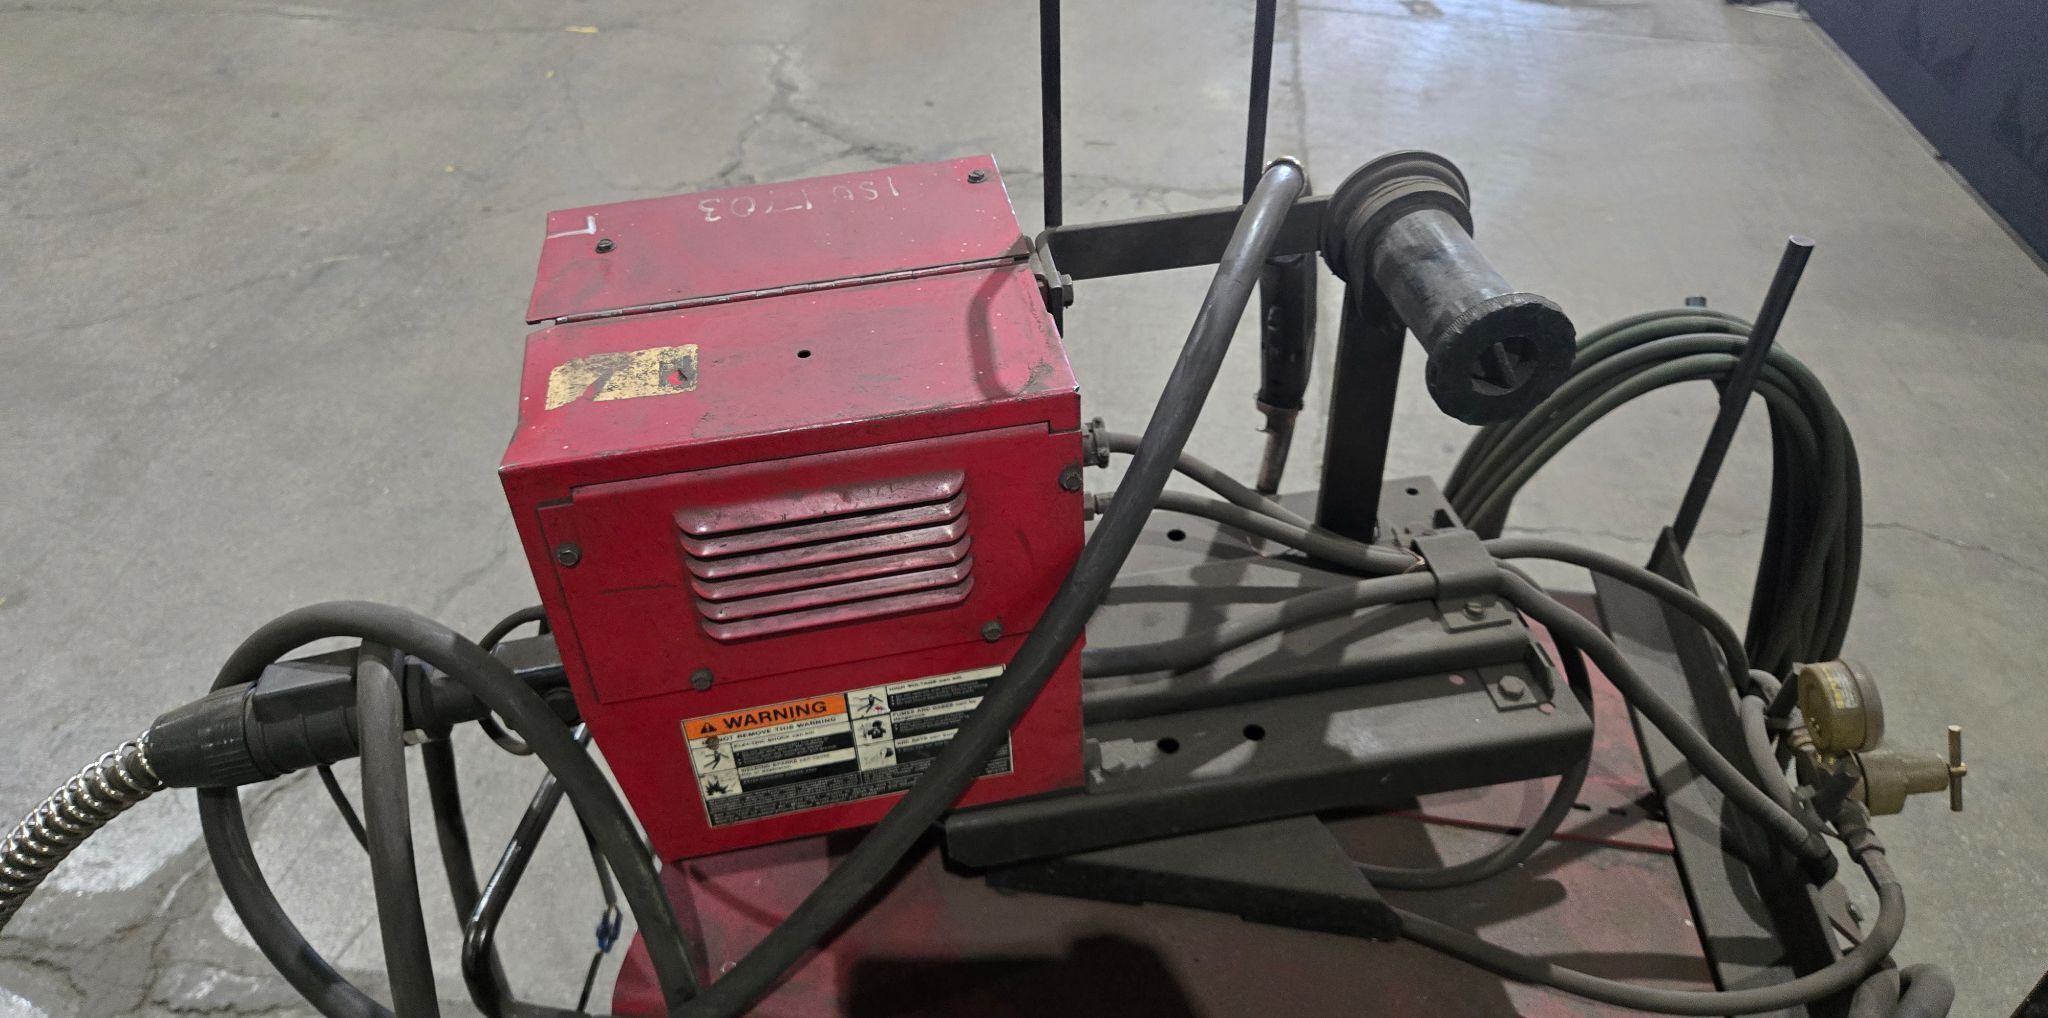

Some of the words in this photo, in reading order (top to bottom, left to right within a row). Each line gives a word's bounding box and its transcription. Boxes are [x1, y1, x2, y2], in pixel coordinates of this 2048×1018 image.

[723, 700, 828, 730] WARNING
[737, 728, 772, 739] REMOVE
[796, 717, 837, 728] WARNING
